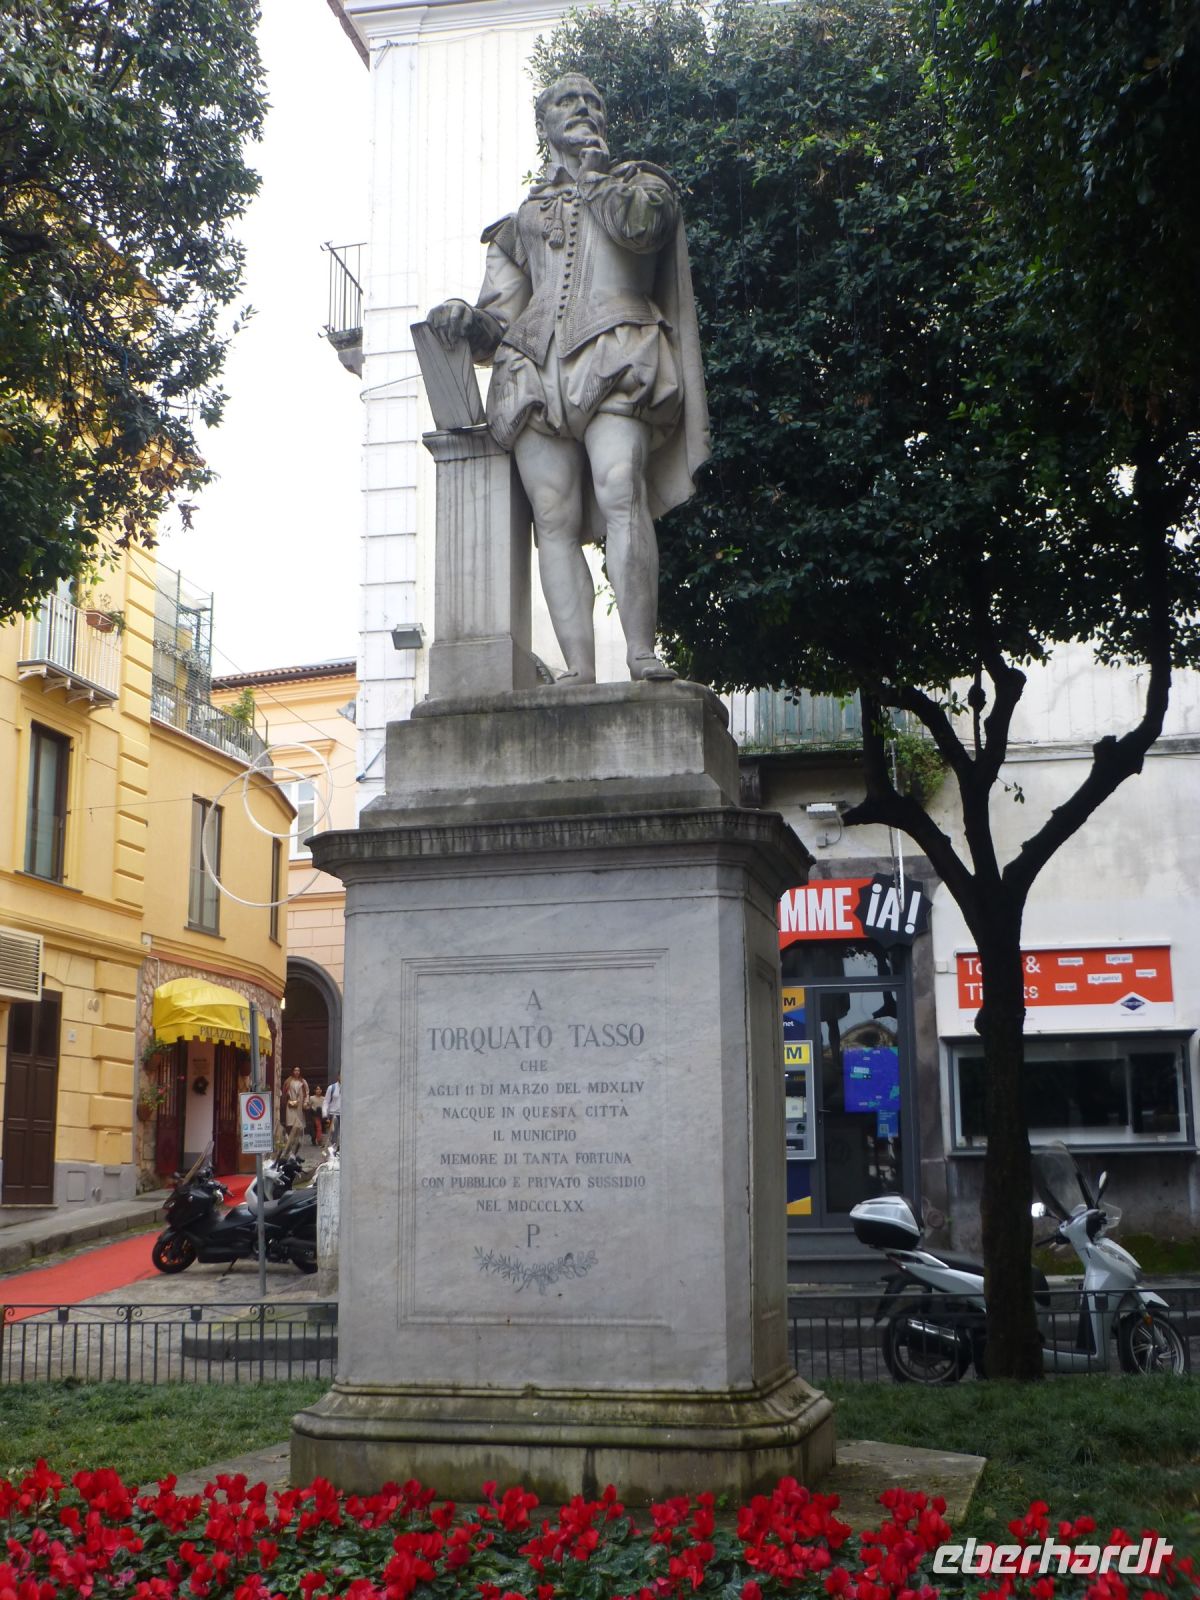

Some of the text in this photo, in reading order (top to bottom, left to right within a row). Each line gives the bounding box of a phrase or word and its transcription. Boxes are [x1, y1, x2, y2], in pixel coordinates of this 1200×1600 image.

[778, 887, 853, 932] MME
[1025, 956, 1041, 973] &
[525, 989, 543, 1011] A
[200, 1025, 233, 1040] PALAZZO
[427, 1022, 645, 1054] TORQUATO TASSO
[520, 1059, 548, 1072] CHE
[428, 1084, 459, 1096] AGLI
[481, 1083, 494, 1095] DI
[500, 1083, 549, 1095] MARZO
[556, 1082, 581, 1094] DEL
[587, 1081, 645, 1094] MDXLIV
[442, 1106, 496, 1121] NACQUE
[502, 1106, 514, 1119] IN
[522, 1105, 577, 1121] QUESTA
[493, 1129, 577, 1142] IL MUNICIPIO
[440, 1152, 632, 1165] MEMORE DI TANTA FORTUNA
[421, 1175, 646, 1189] CON PUBBLICO E PRIVATO SUSSIDIO
[476, 1200, 585, 1212] NEL MDCCCLXX
